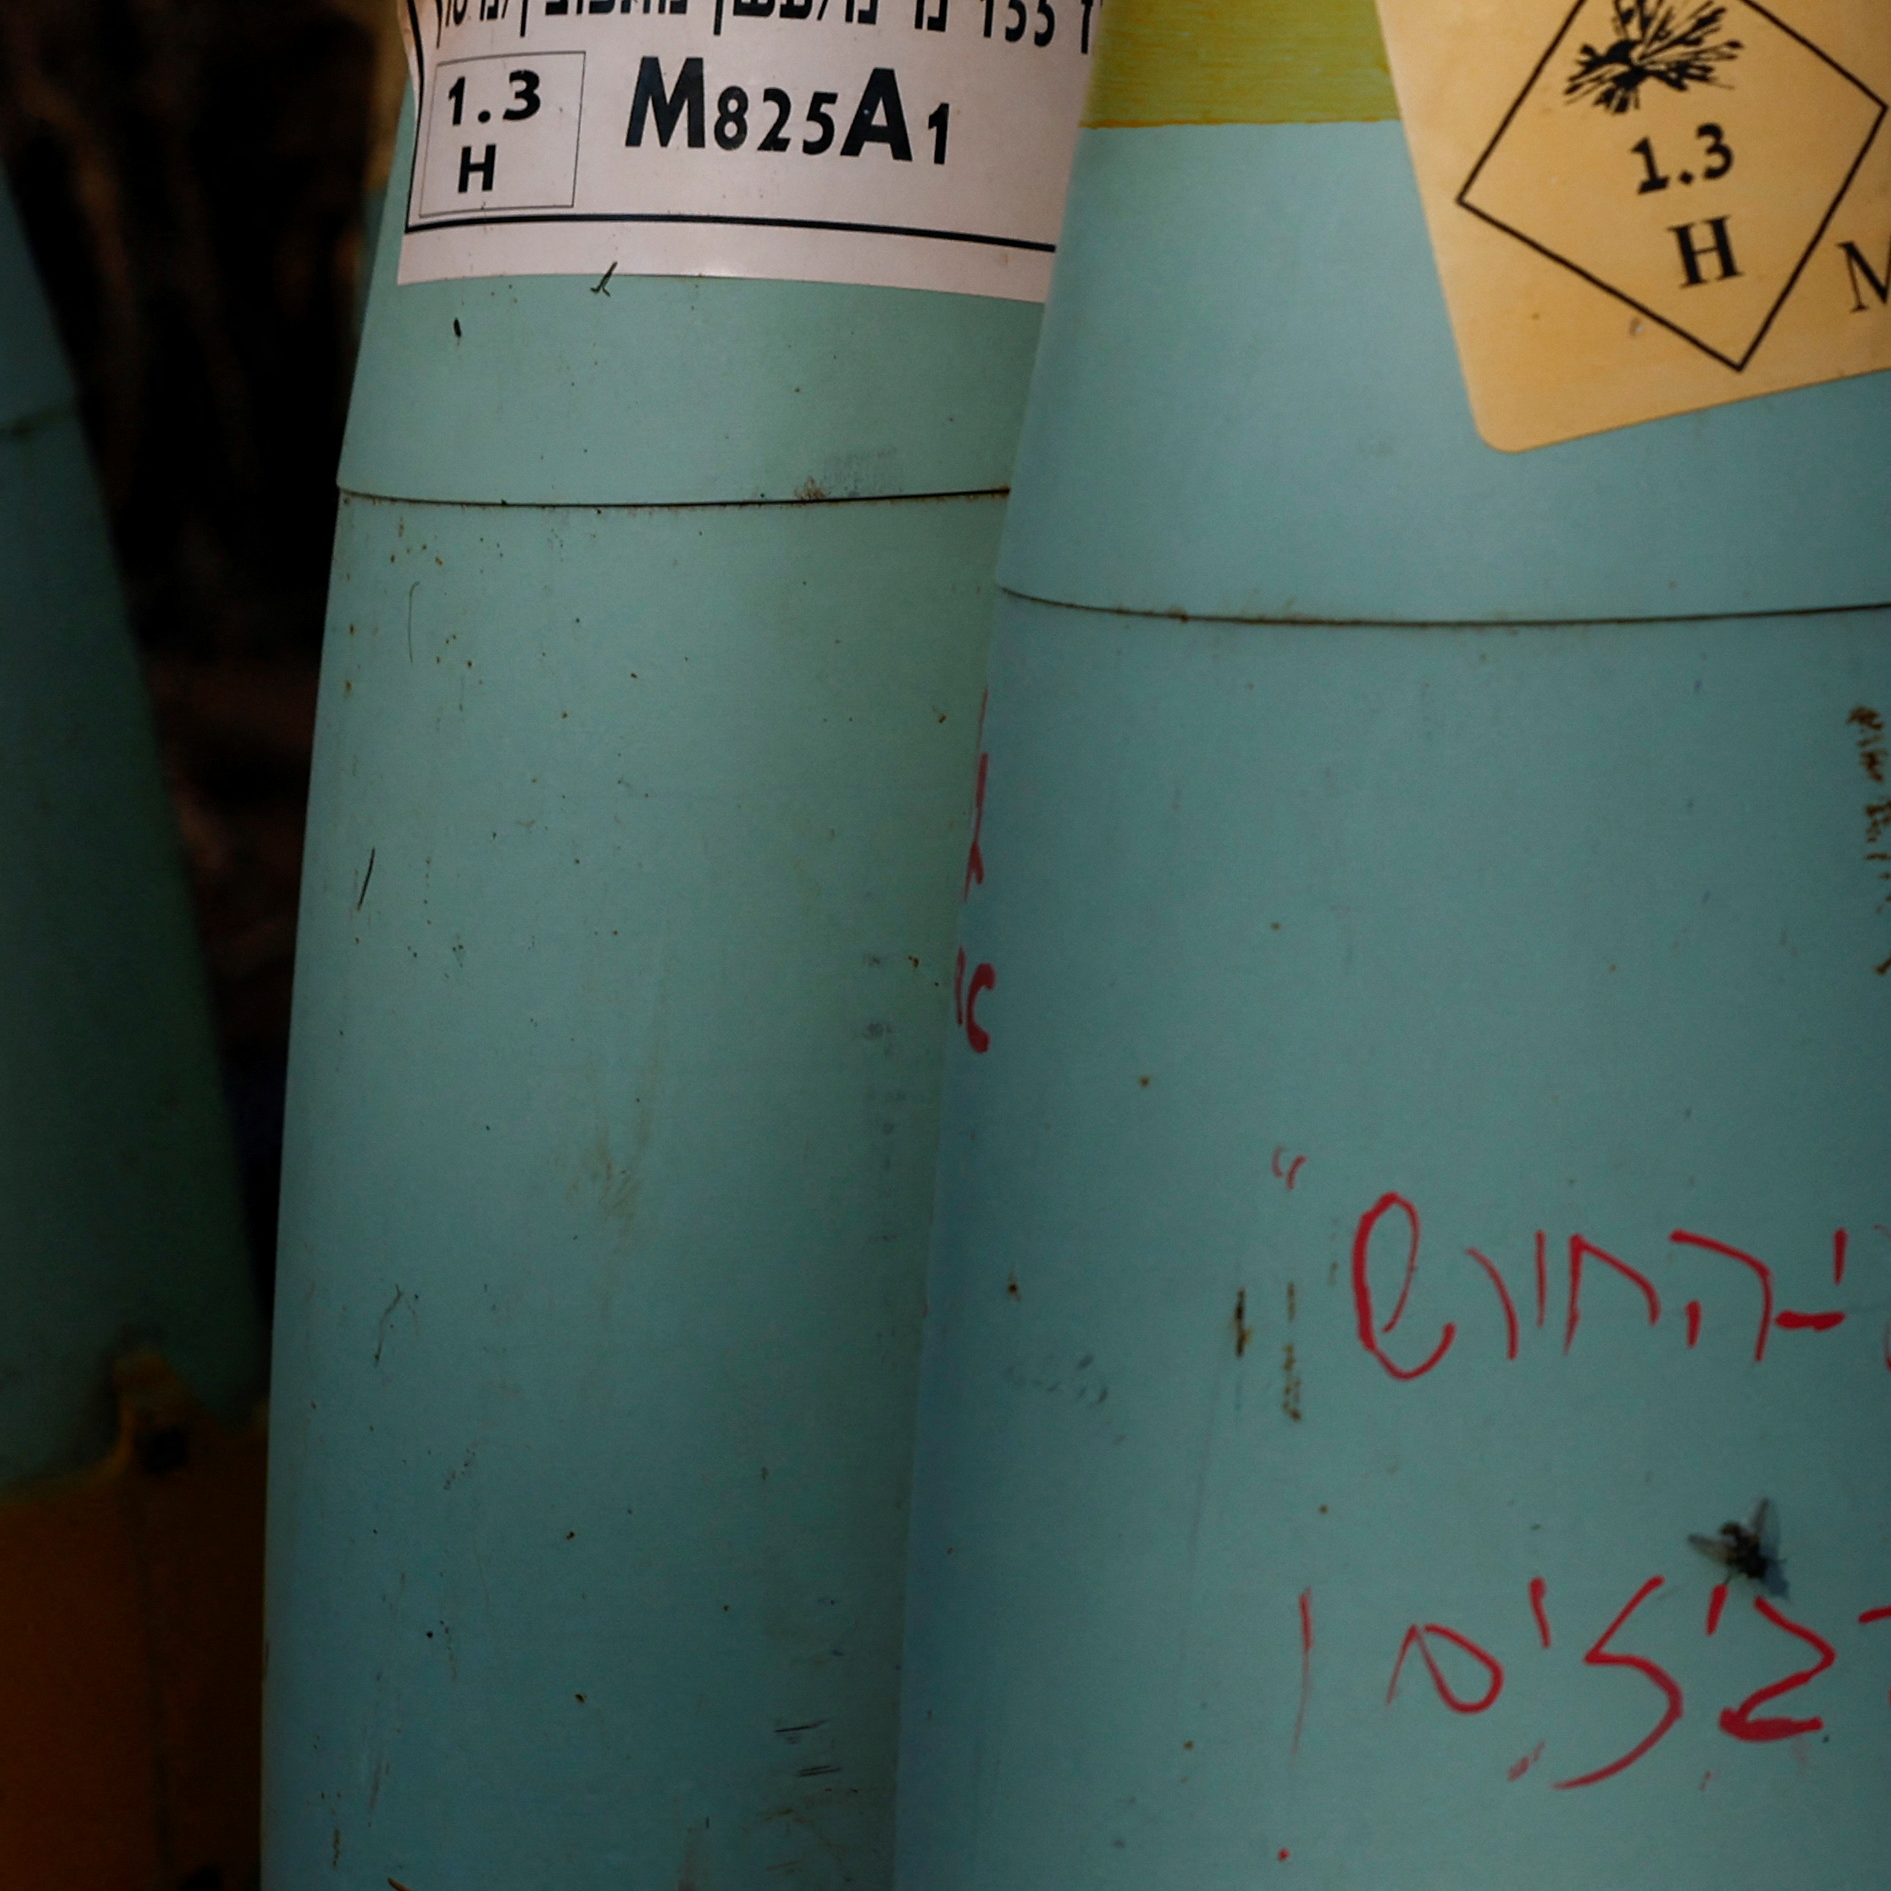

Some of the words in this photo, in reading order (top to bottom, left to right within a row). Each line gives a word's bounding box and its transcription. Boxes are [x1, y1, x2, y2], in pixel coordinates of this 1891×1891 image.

[447, 69, 542, 126] 1.3
[624, 55, 951, 166] M825A1
[457, 143, 498, 194] H
[1628, 122, 1735, 195] 1.3
[1666, 214, 1745, 289] H
